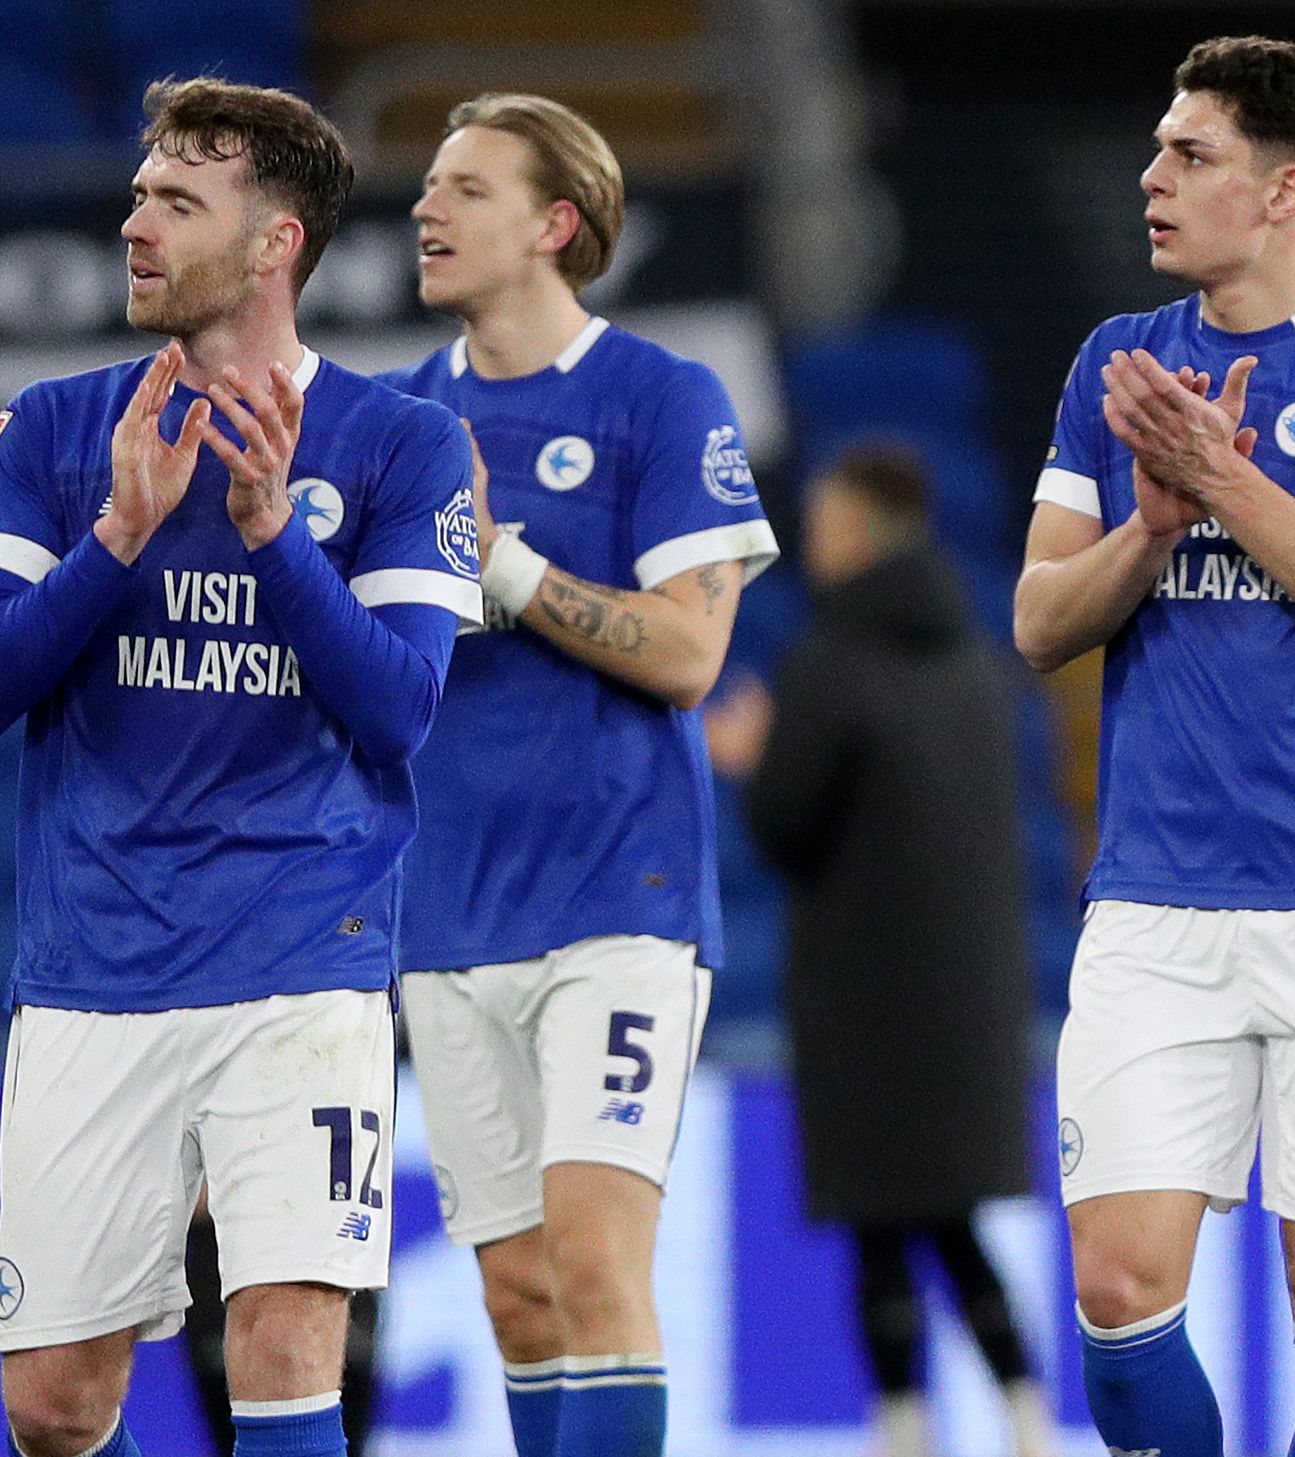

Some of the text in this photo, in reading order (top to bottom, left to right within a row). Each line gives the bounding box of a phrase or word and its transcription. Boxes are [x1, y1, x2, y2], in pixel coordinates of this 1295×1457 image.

[434, 511, 477, 537] WATC
[464, 537, 480, 561] BA
[164, 569, 257, 626] VISIT
[1154, 553, 1292, 601] ALAYSI
[117, 635, 301, 696] MALAYSIA
[605, 1010, 655, 1093] 5
[312, 1106, 383, 1209] 12
